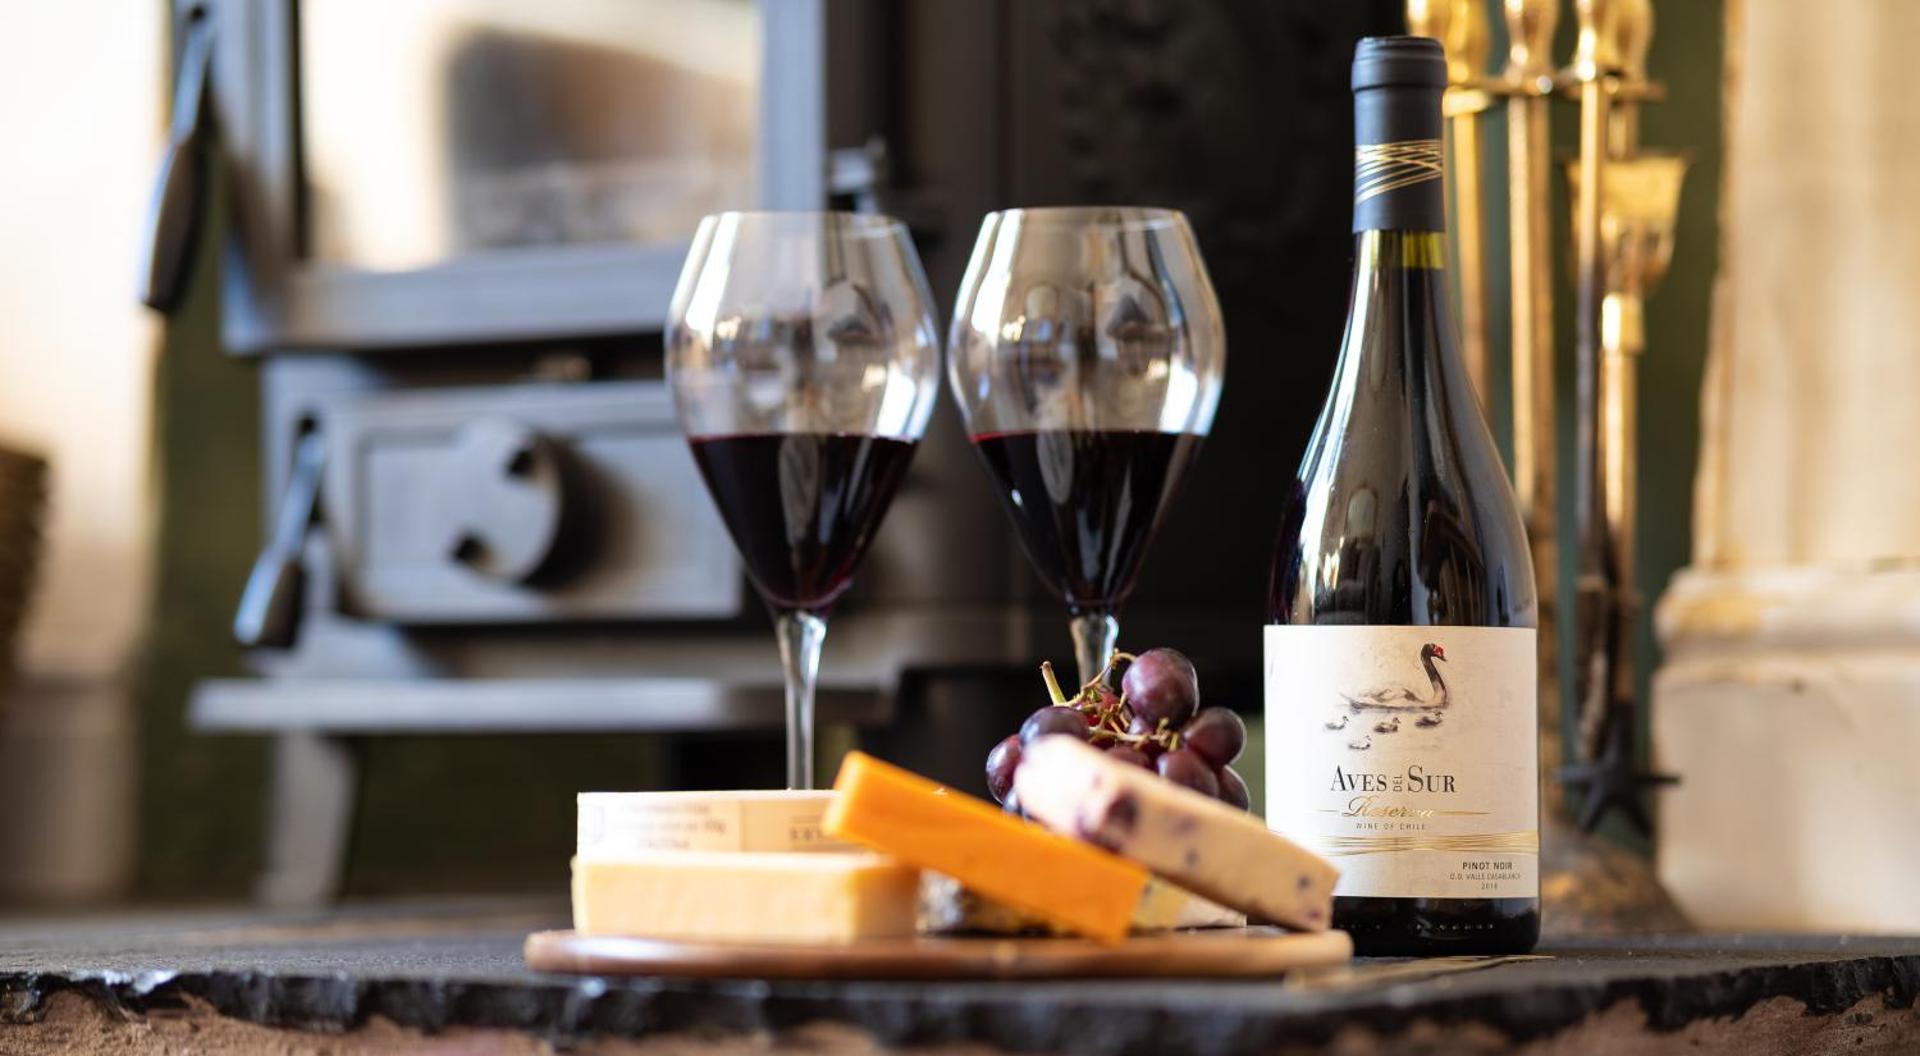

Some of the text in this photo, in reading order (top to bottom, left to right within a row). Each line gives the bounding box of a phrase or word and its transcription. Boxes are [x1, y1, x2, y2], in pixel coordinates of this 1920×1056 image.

[1330, 764, 1387, 792] AVES
[1407, 764, 1457, 793] SUR
[1462, 862, 1513, 870] PINOT NOIR
